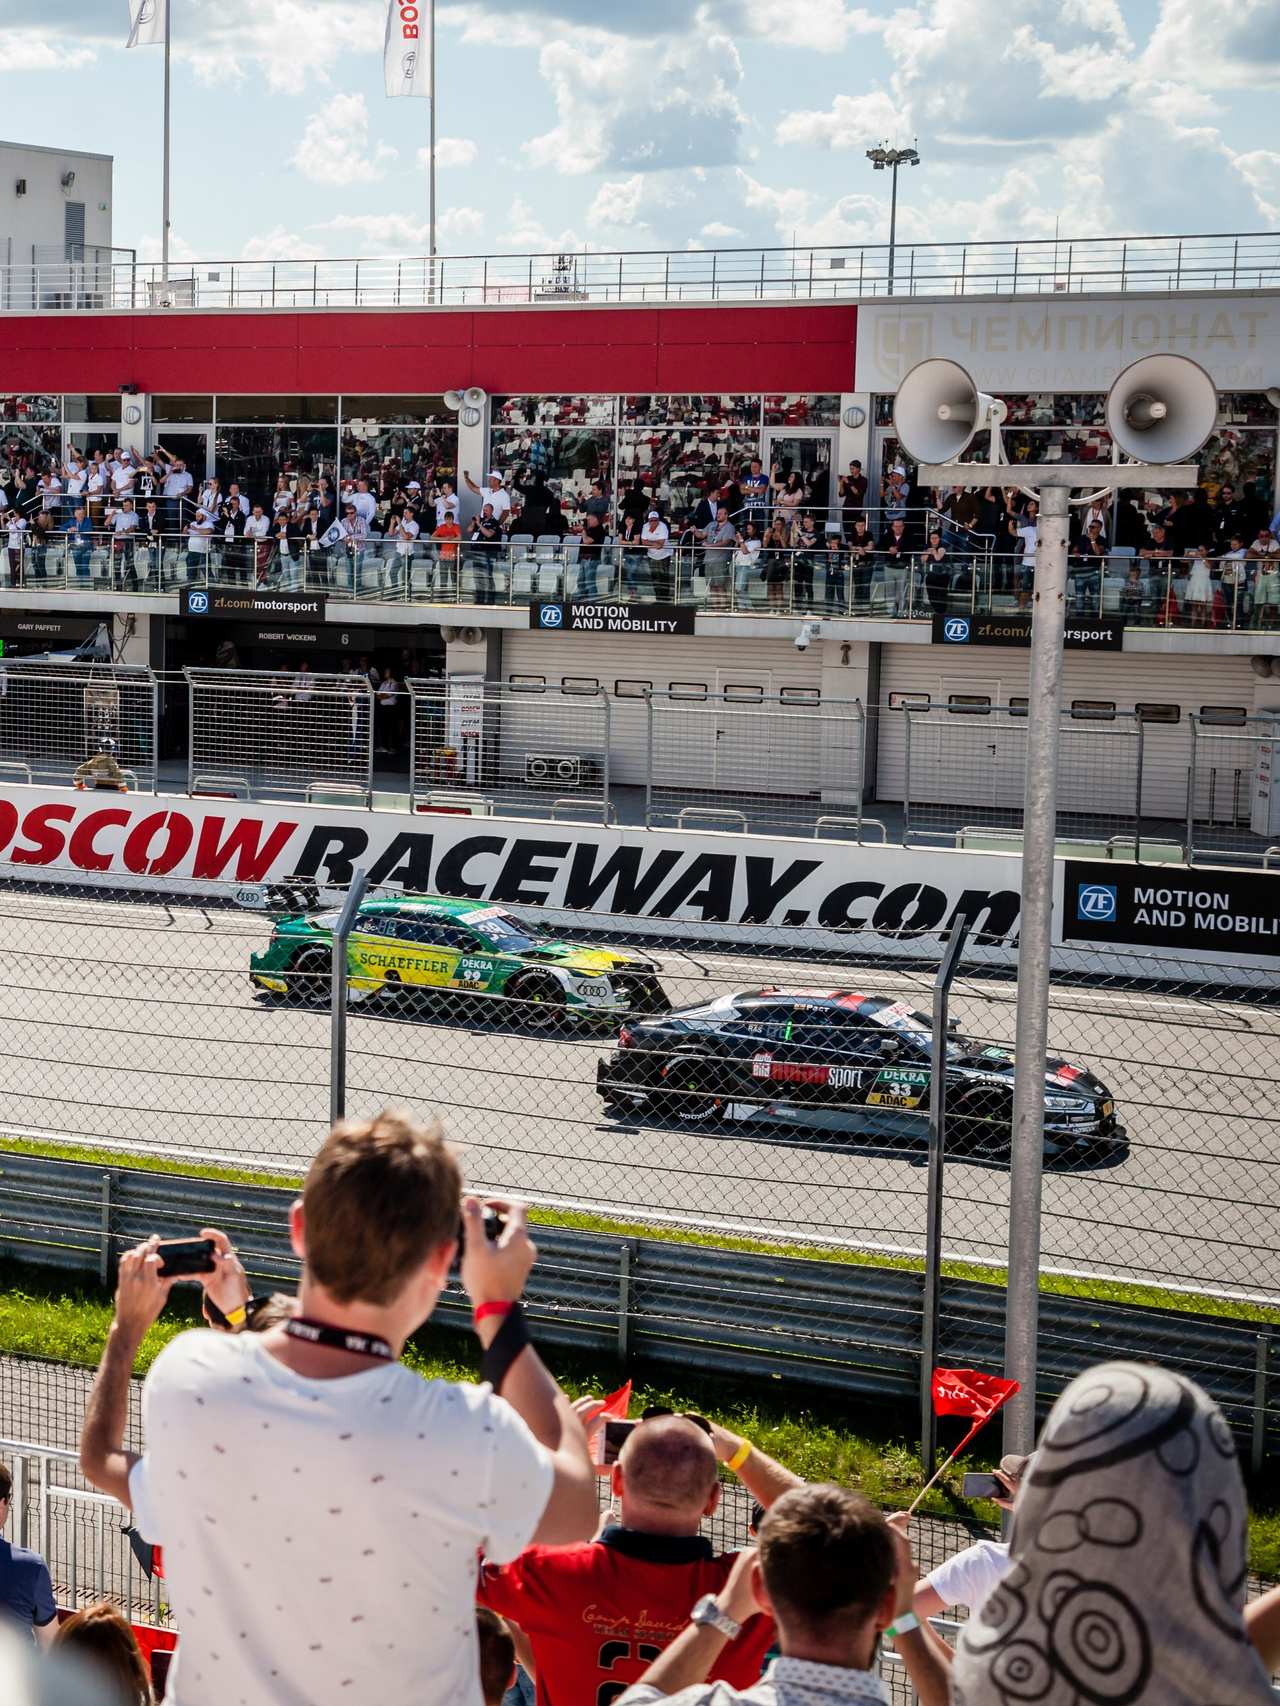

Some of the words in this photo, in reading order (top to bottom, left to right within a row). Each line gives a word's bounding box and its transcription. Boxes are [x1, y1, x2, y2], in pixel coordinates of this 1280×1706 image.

[950, 311, 1269, 352] ЧЕМПИОНАТ
[214, 597, 318, 613] zf.com/motorsport
[572, 604, 629, 619] MOTION
[17, 623, 34, 631] GARY
[34, 623, 62, 632] PAFFETT
[572, 616, 614, 629] AND
[619, 618, 678, 633] MOBILITY
[258, 632, 284, 641] ROBERT
[286, 633, 317, 642] WICKENS
[341, 634, 349, 645] 6
[1133, 887, 1230, 911] MOTION
[1133, 908, 1187, 928] AND
[1193, 912, 1280, 935] MOBILI
[359, 952, 450, 974] SCHAEFFLER
[460, 958, 494, 971] DEKRA
[463, 970, 481, 982] 99
[457, 981, 480, 990] ADAC
[883, 1070, 926, 1084] DEKRA
[888, 1083, 912, 1097] 33
[878, 1093, 908, 1107] ADAC
[582, 1603, 631, 1630] Camp
[633, 1609, 690, 1632] David
[592, 1623, 631, 1638] TEAM
